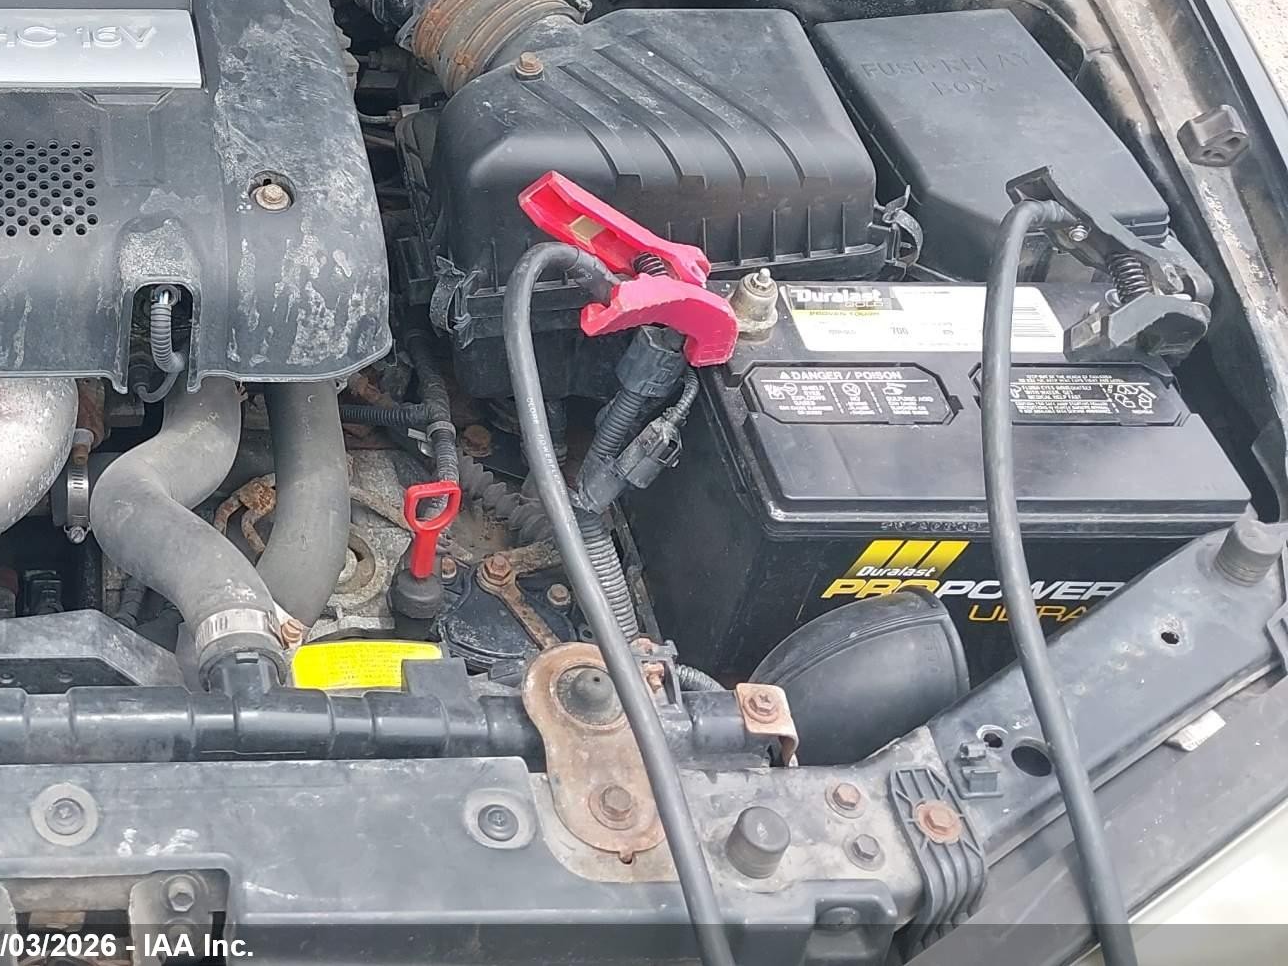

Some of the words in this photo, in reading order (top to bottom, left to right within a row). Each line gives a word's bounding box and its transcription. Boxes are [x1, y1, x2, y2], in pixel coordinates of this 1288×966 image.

[74, 24, 157, 49] 16V
[790, 288, 883, 304] Duralast
[789, 371, 843, 380] DANGER
[854, 371, 902, 380] POISON
[856, 565, 937, 578] Duralast
